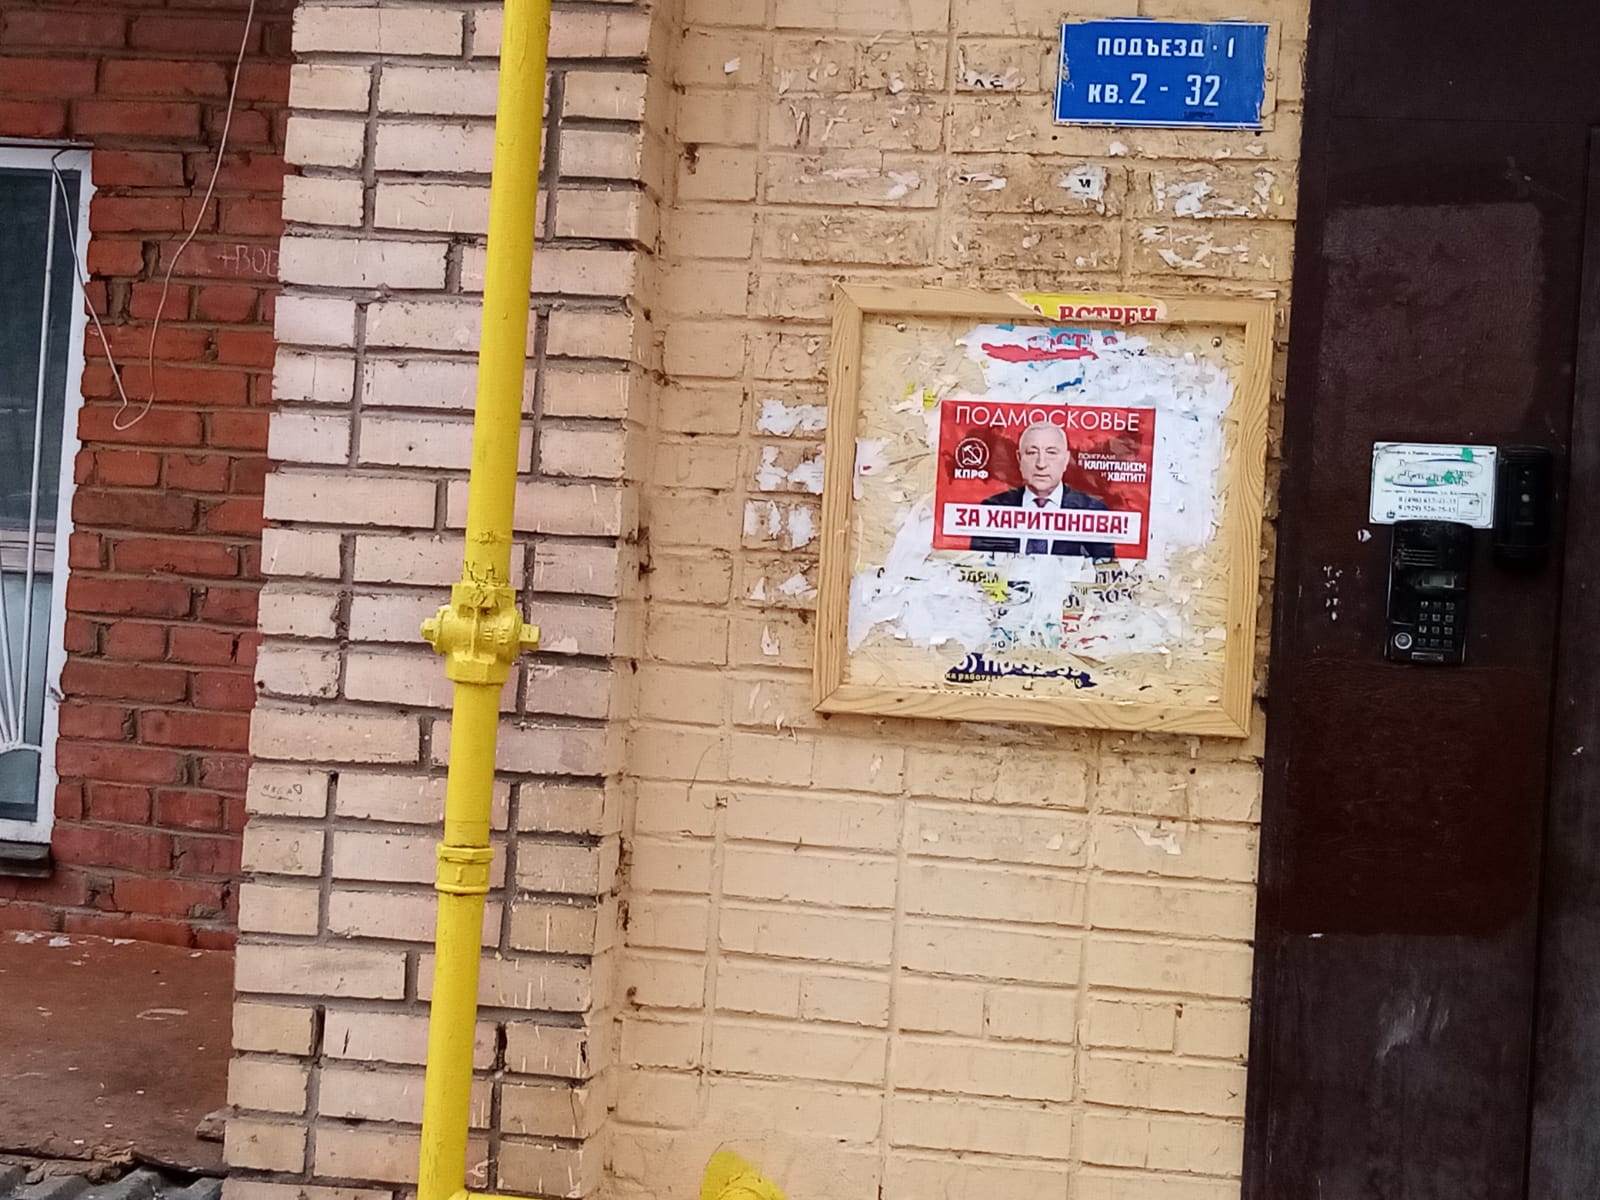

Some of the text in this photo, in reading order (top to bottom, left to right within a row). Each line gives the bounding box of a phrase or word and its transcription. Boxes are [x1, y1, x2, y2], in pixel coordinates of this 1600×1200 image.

[1097, 37, 1205, 57] ПОДЪЕЗД
[1185, 74, 1221, 107] 32
[955, 405, 1140, 432] ПОДМОСКОВЬЕ
[954, 468, 989, 479] КПРФ
[1084, 460, 1147, 472] КАПИТАЛИЗМ
[955, 508, 1129, 535] ЗА ХАРИТОНОВА!
